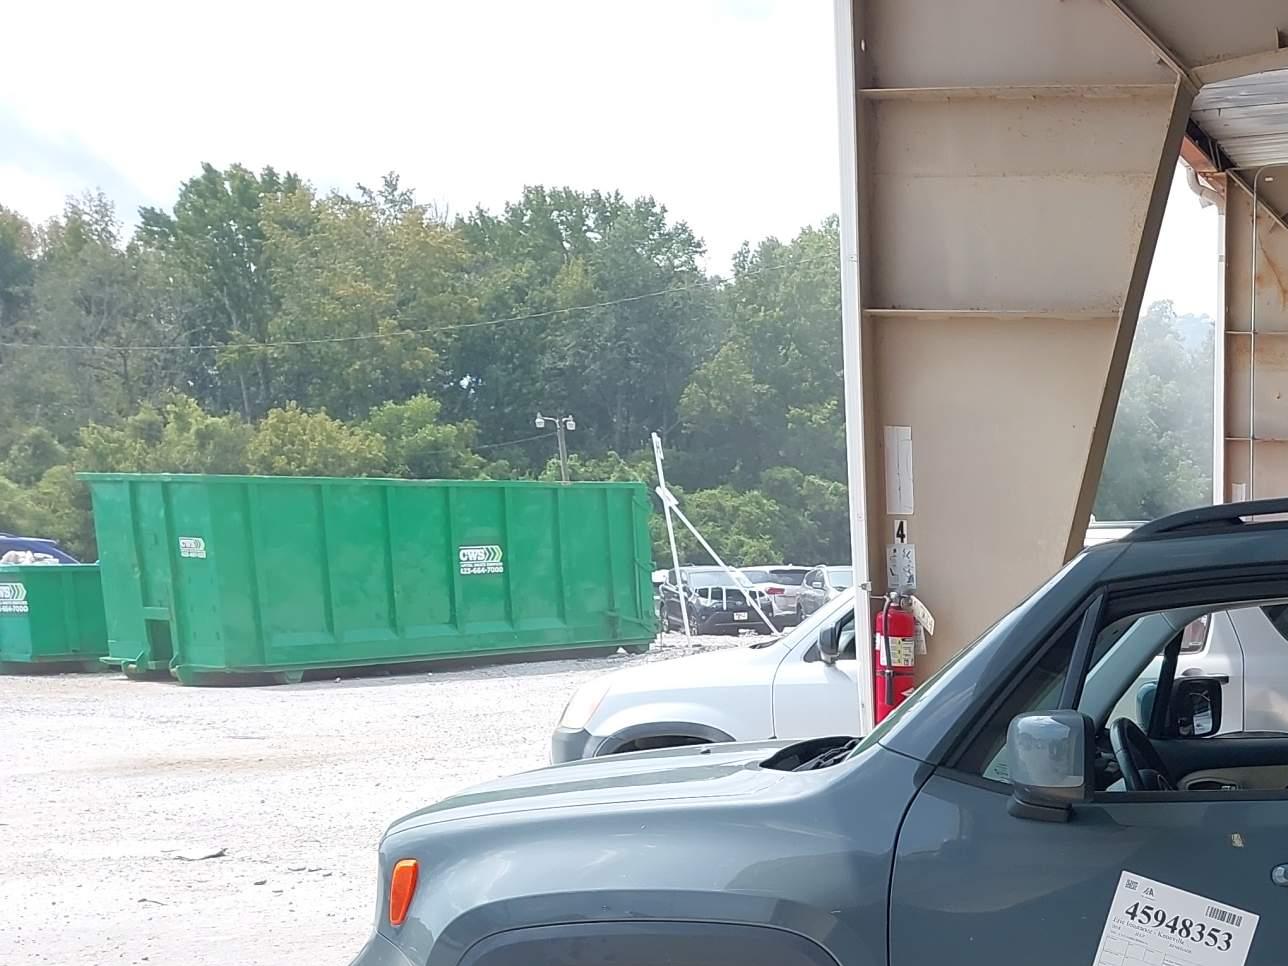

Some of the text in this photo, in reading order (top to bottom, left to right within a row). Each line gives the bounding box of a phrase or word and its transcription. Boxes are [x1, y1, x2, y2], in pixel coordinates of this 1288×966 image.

[896, 520, 906, 543] 4
[459, 549, 485, 561] CWS
[1125, 901, 1233, 952] 45948353
